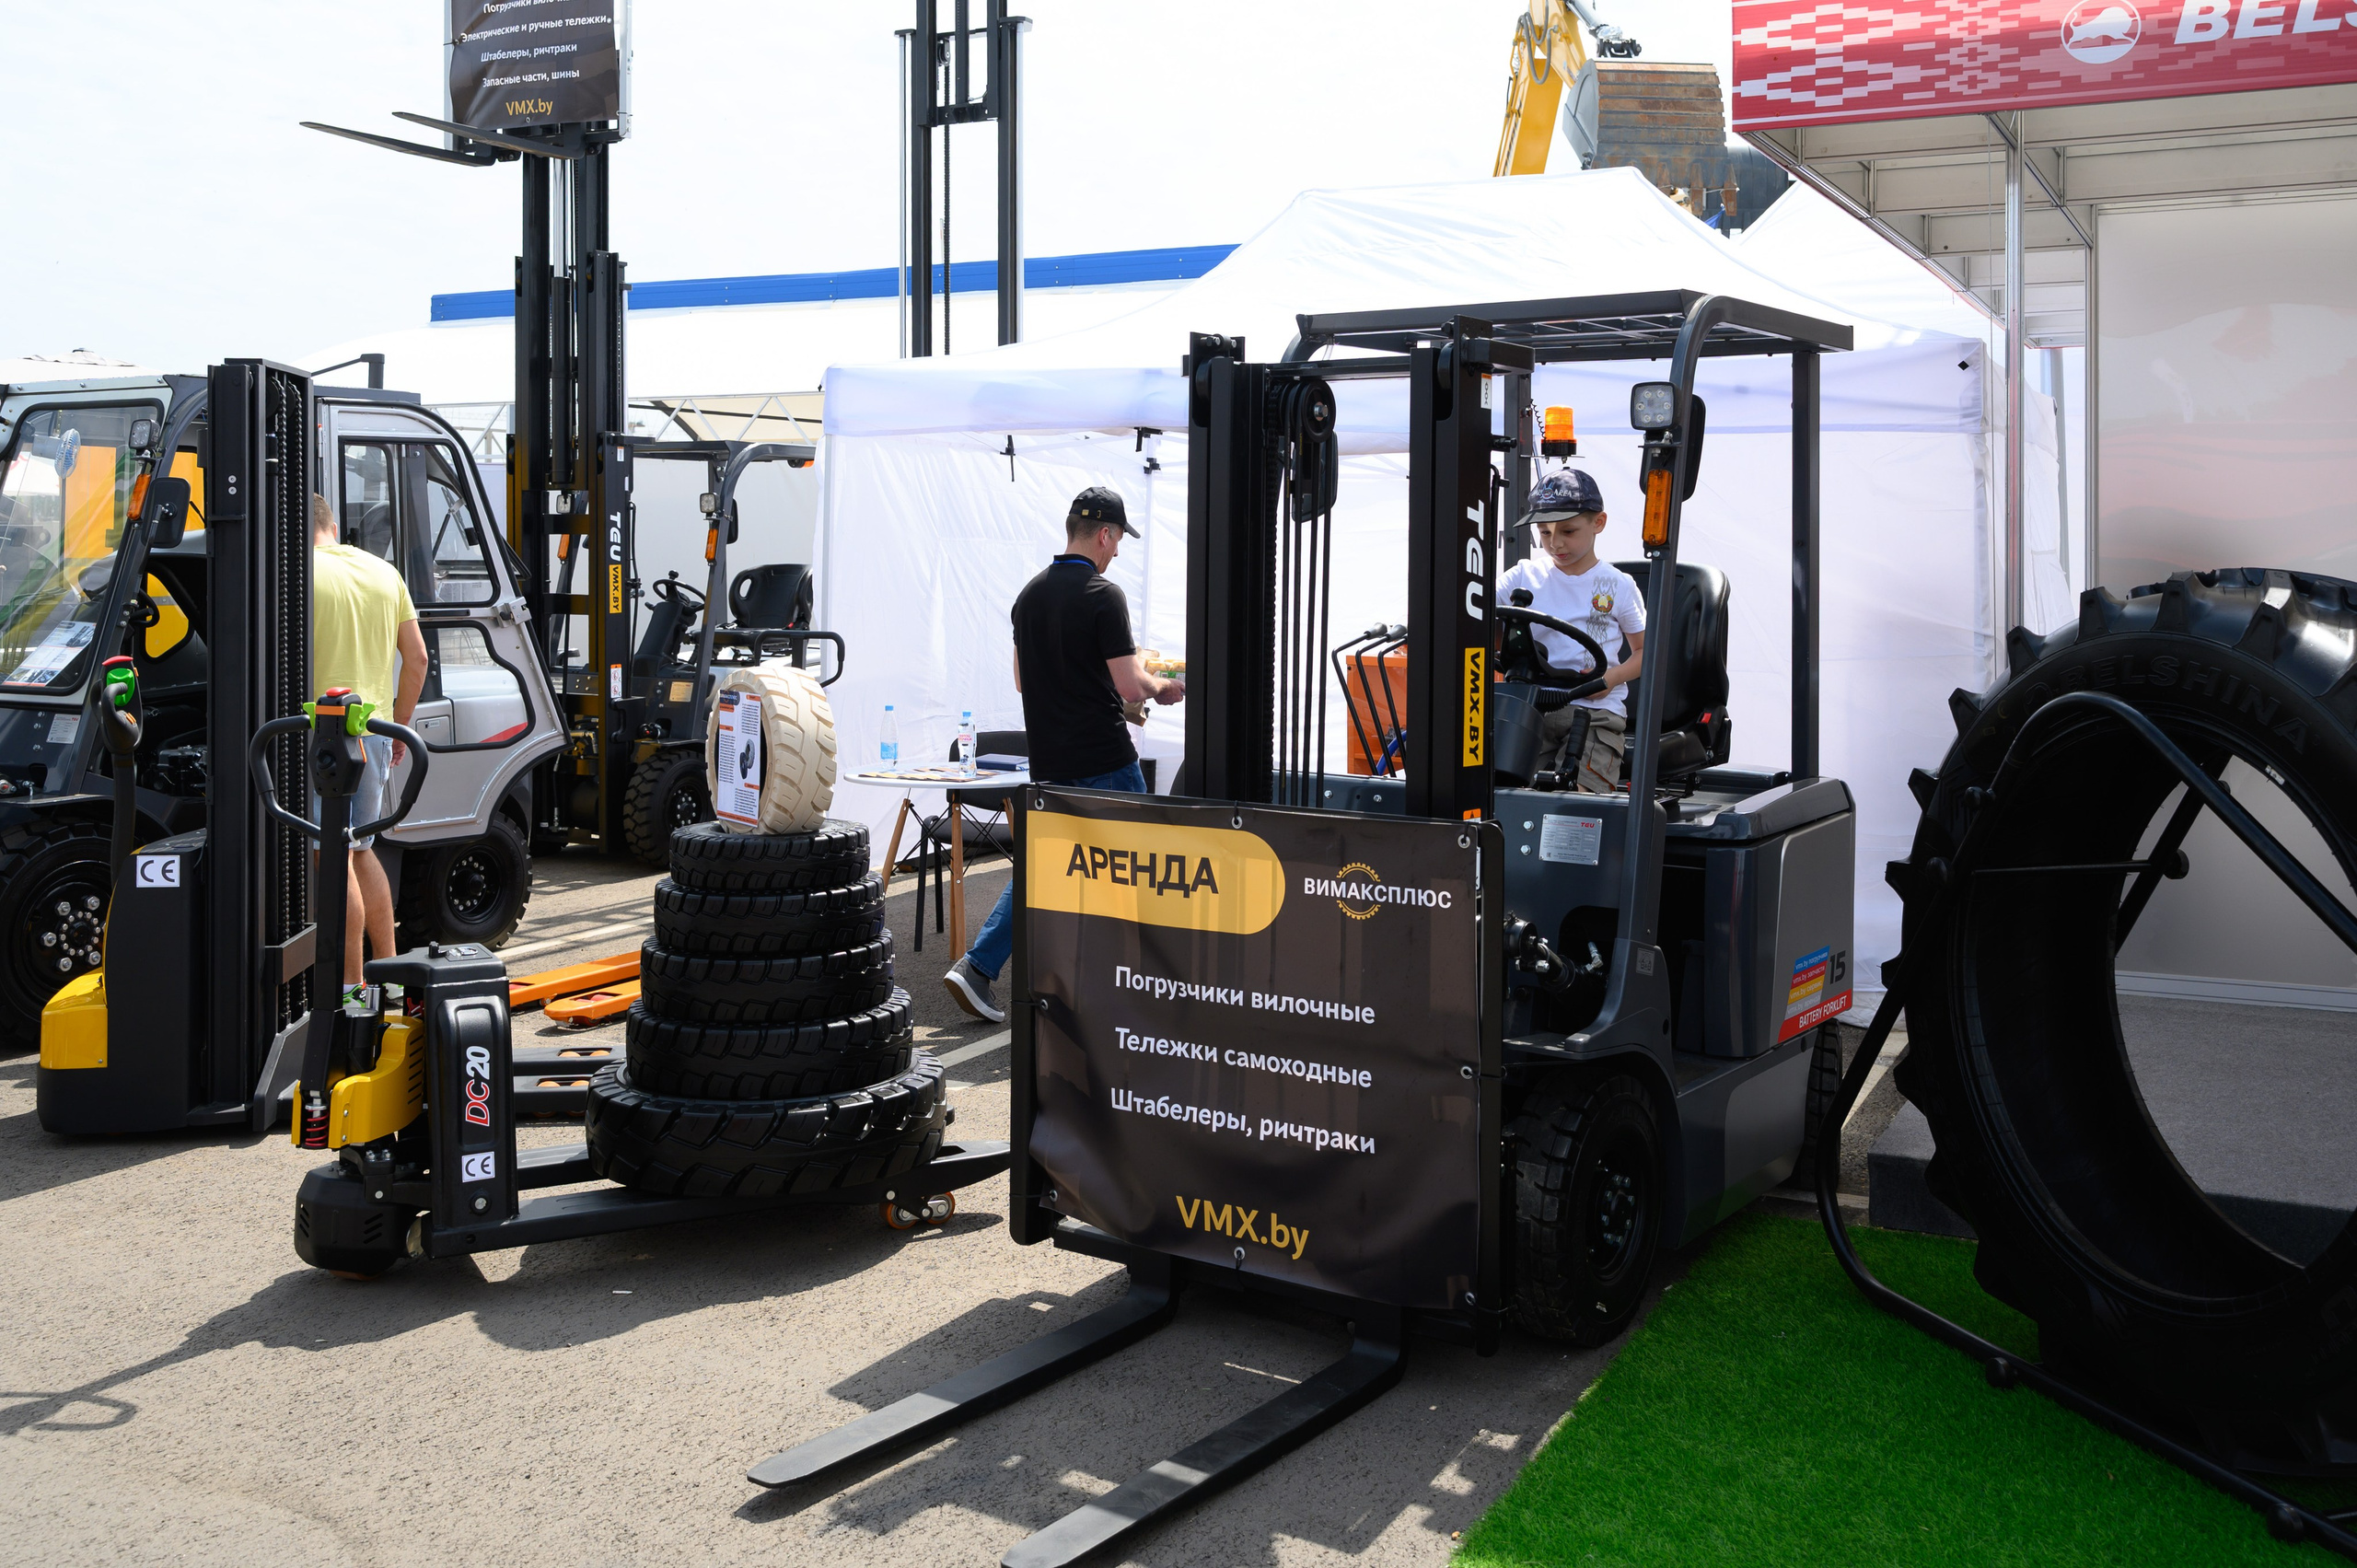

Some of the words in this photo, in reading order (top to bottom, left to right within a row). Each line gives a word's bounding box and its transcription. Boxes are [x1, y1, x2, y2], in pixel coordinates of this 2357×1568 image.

[460, 25, 520, 43] Электрические
[521, 23, 528, 32] и
[528, 17, 563, 33] ручные
[564, 15, 607, 27] тележки
[481, 49, 532, 63] Штабелеры,
[533, 43, 578, 59] ричтраки
[482, 74, 521, 87] Запасные
[522, 72, 550, 83] части,
[552, 69, 580, 81] шины
[505, 99, 553, 116] VMX.by
[1469, 651, 1480, 762] VMX.BY
[140, 860, 176, 883] CE
[1066, 843, 1220, 899] АРЕНДА
[1304, 877, 1452, 910] ВИМАКСПЛЮС
[1829, 950, 1846, 984] 15
[1115, 965, 1245, 1007] Погрузчики
[1251, 992, 1376, 1025] вилочные
[1799, 1007, 1823, 1028] BATTERY
[1823, 995, 1847, 1016] FORKLIFT
[1115, 1027, 1218, 1063] Тележки
[1225, 1046, 1373, 1088] самоходные
[1110, 1087, 1253, 1137] Штабелеры,
[1260, 1117, 1376, 1155] ричтраки
[465, 1156, 492, 1178] CE
[1176, 1194, 1309, 1260] VMX.by
